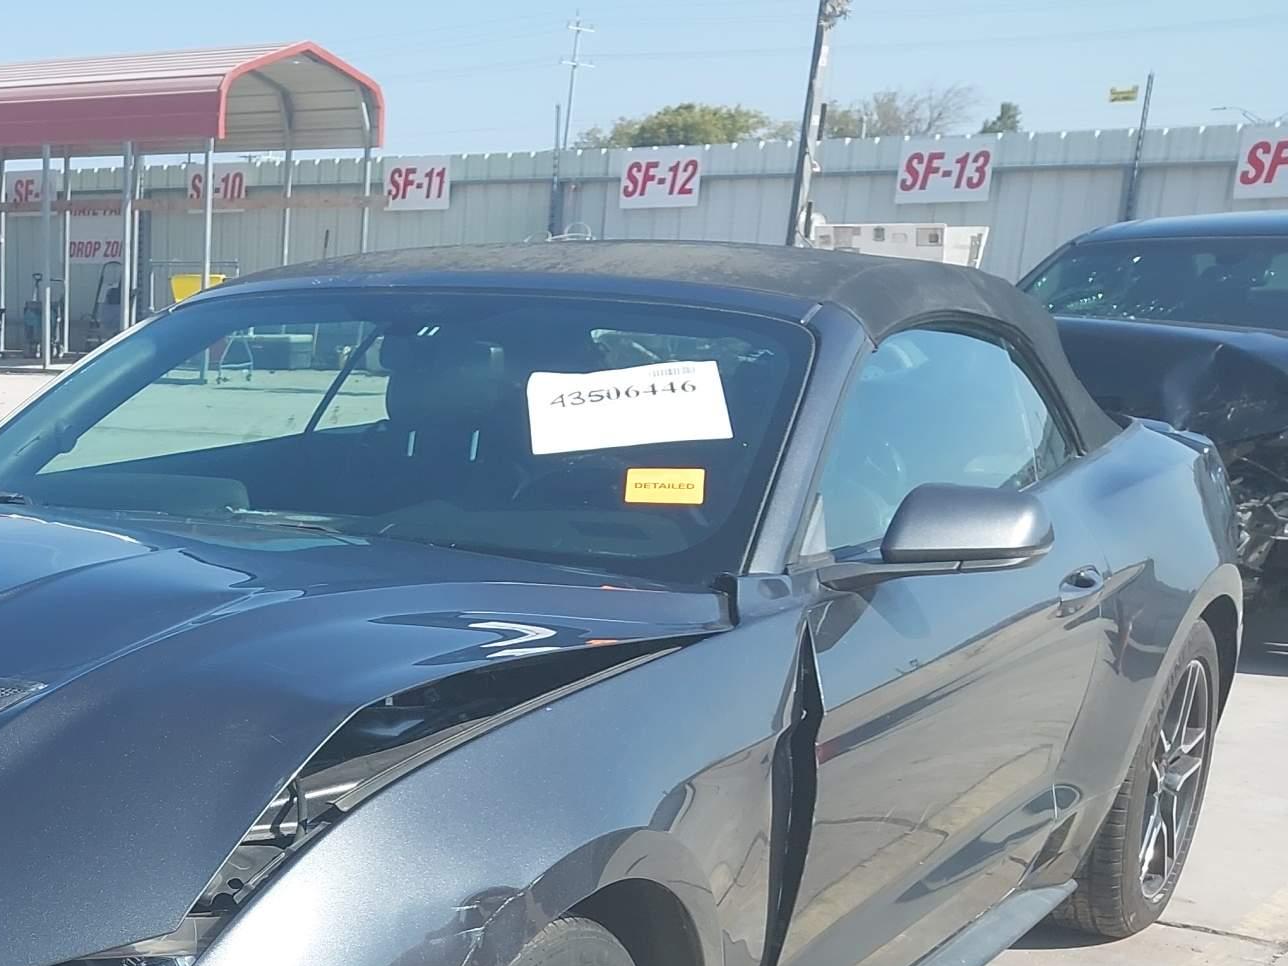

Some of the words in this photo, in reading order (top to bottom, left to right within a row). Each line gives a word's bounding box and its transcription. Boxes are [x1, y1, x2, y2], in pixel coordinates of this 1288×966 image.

[387, 167, 446, 200] SF-11
[623, 159, 698, 197] SF-12
[900, 150, 991, 191] SF-13
[13, 179, 41, 203] SF-
[190, 171, 245, 201] S-10
[69, 240, 101, 258] DROP
[550, 379, 697, 408] 43506446
[634, 482, 696, 490] DETAILED
